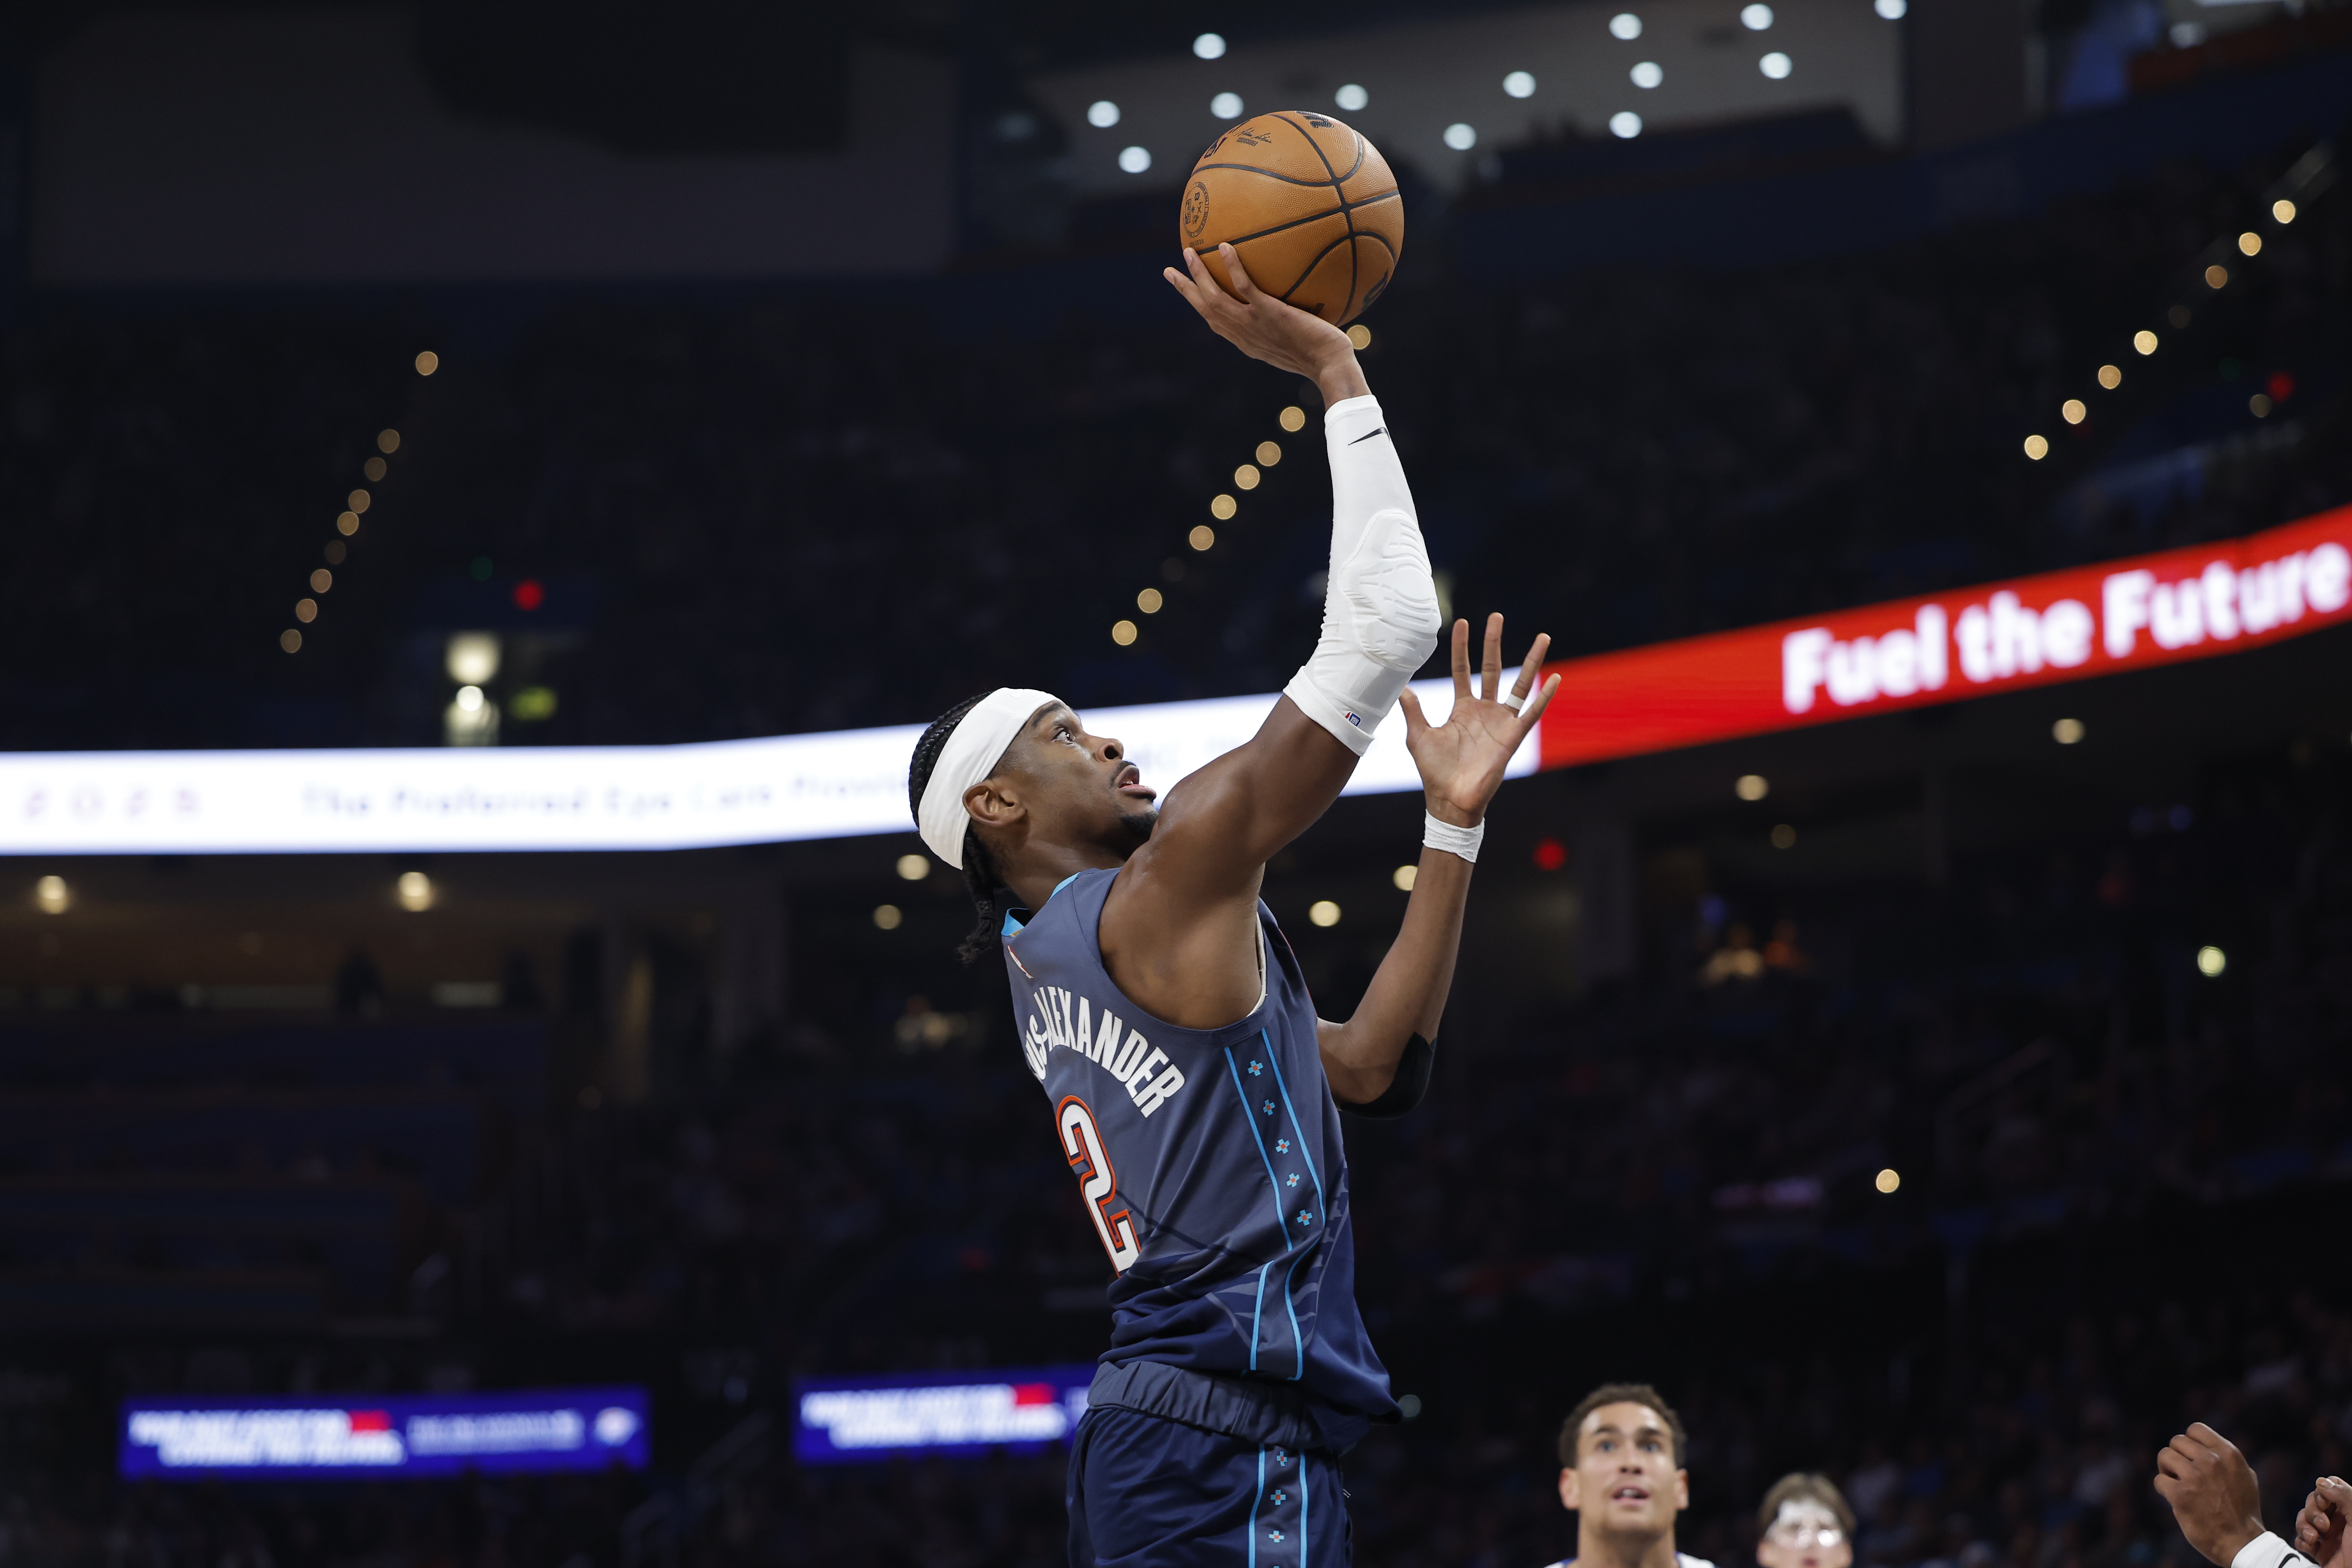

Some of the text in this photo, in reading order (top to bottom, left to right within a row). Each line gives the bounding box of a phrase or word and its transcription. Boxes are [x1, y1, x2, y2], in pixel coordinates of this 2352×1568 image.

[1782, 544, 2351, 711] Fuel the Future
[1350, 715, 1359, 725] NBA
[1056, 1095, 1142, 1278] 2
